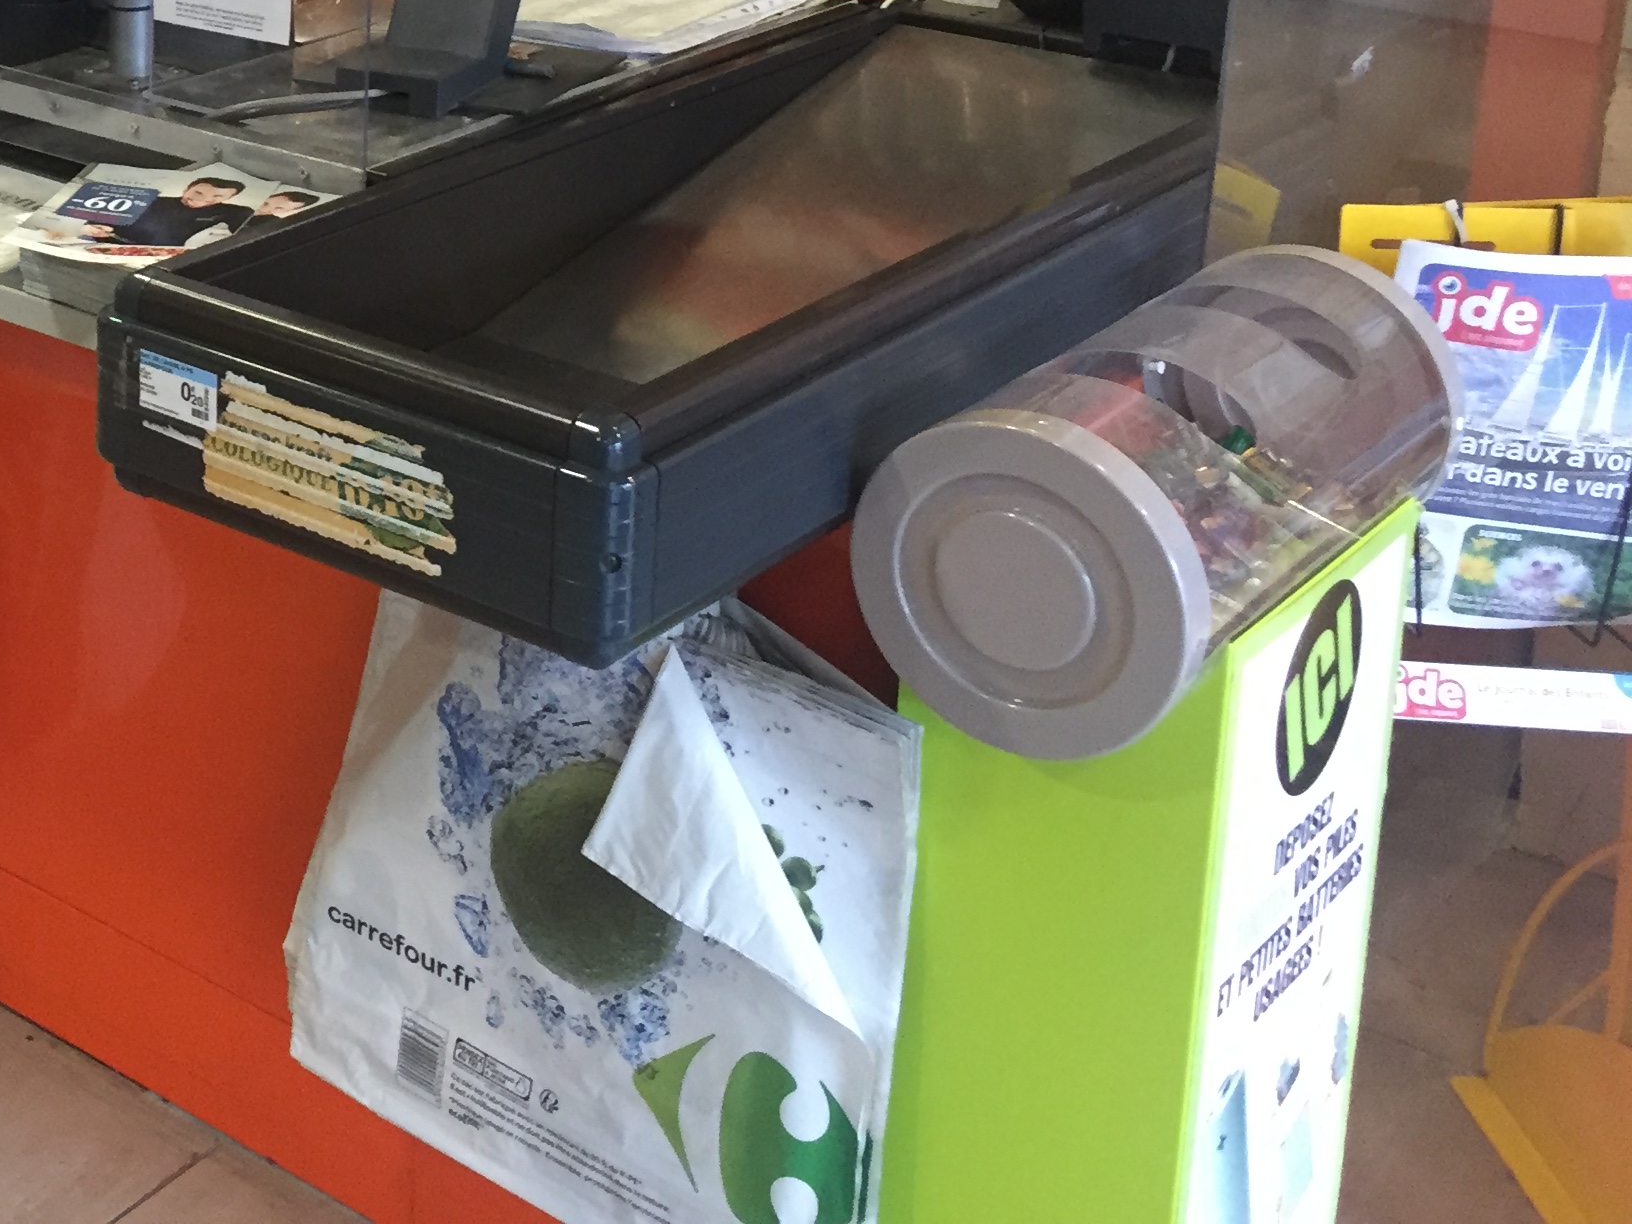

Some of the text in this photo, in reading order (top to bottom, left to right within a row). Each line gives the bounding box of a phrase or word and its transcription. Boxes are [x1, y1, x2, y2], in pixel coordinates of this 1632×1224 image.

[72, 196, 147, 212] -60%
[1437, 274, 1540, 338] jde
[210, 435, 333, 492] COLOGIQUE
[1458, 434, 1562, 465] ateaux
[1544, 470, 1569, 494] le
[1575, 479, 1626, 501] ven
[1284, 593, 1355, 782] ICI
[327, 902, 476, 993] carrefour.fr
[1238, 916, 1292, 997] PETITES
[1296, 843, 1363, 937] BATTERIES
